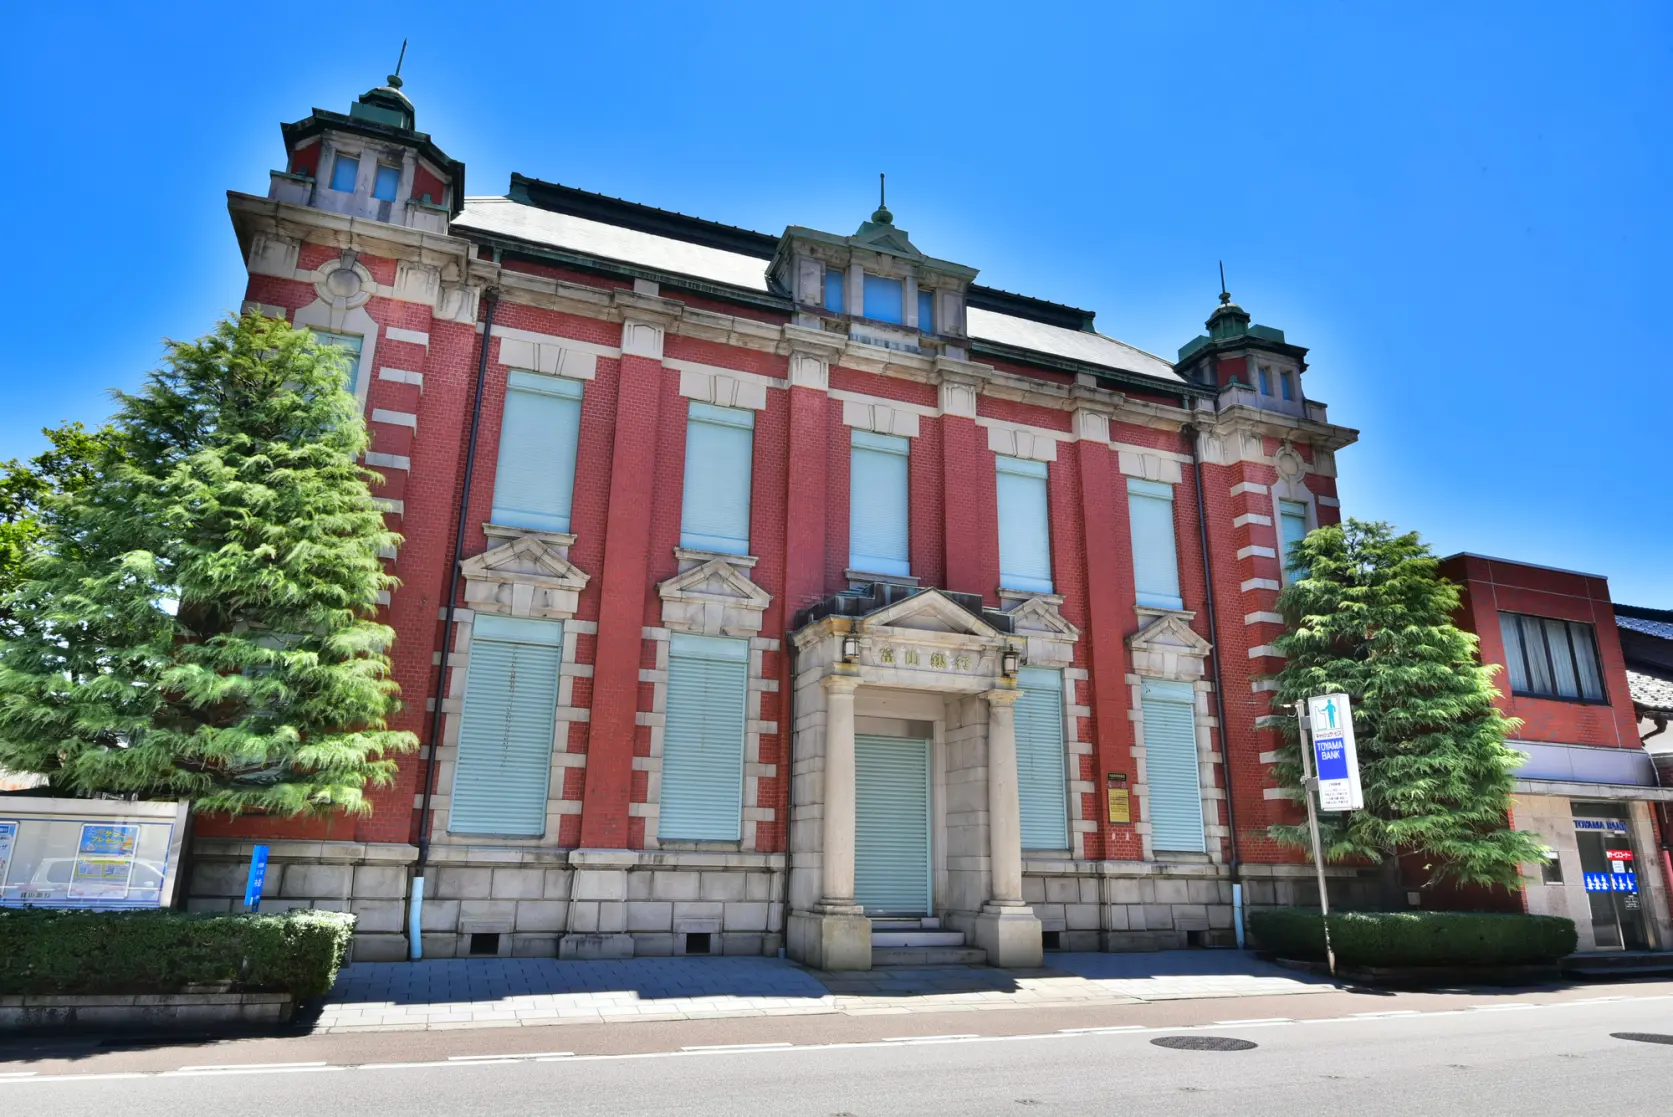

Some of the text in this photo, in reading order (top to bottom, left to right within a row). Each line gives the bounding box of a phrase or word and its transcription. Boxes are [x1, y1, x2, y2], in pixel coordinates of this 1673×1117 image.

[881, 648, 970, 671] 富山銀行
[1317, 740, 1343, 751] TOYAMA
[1321, 750, 1341, 760] BANK
[1574, 820, 1628, 831] TOYAMA BANK
